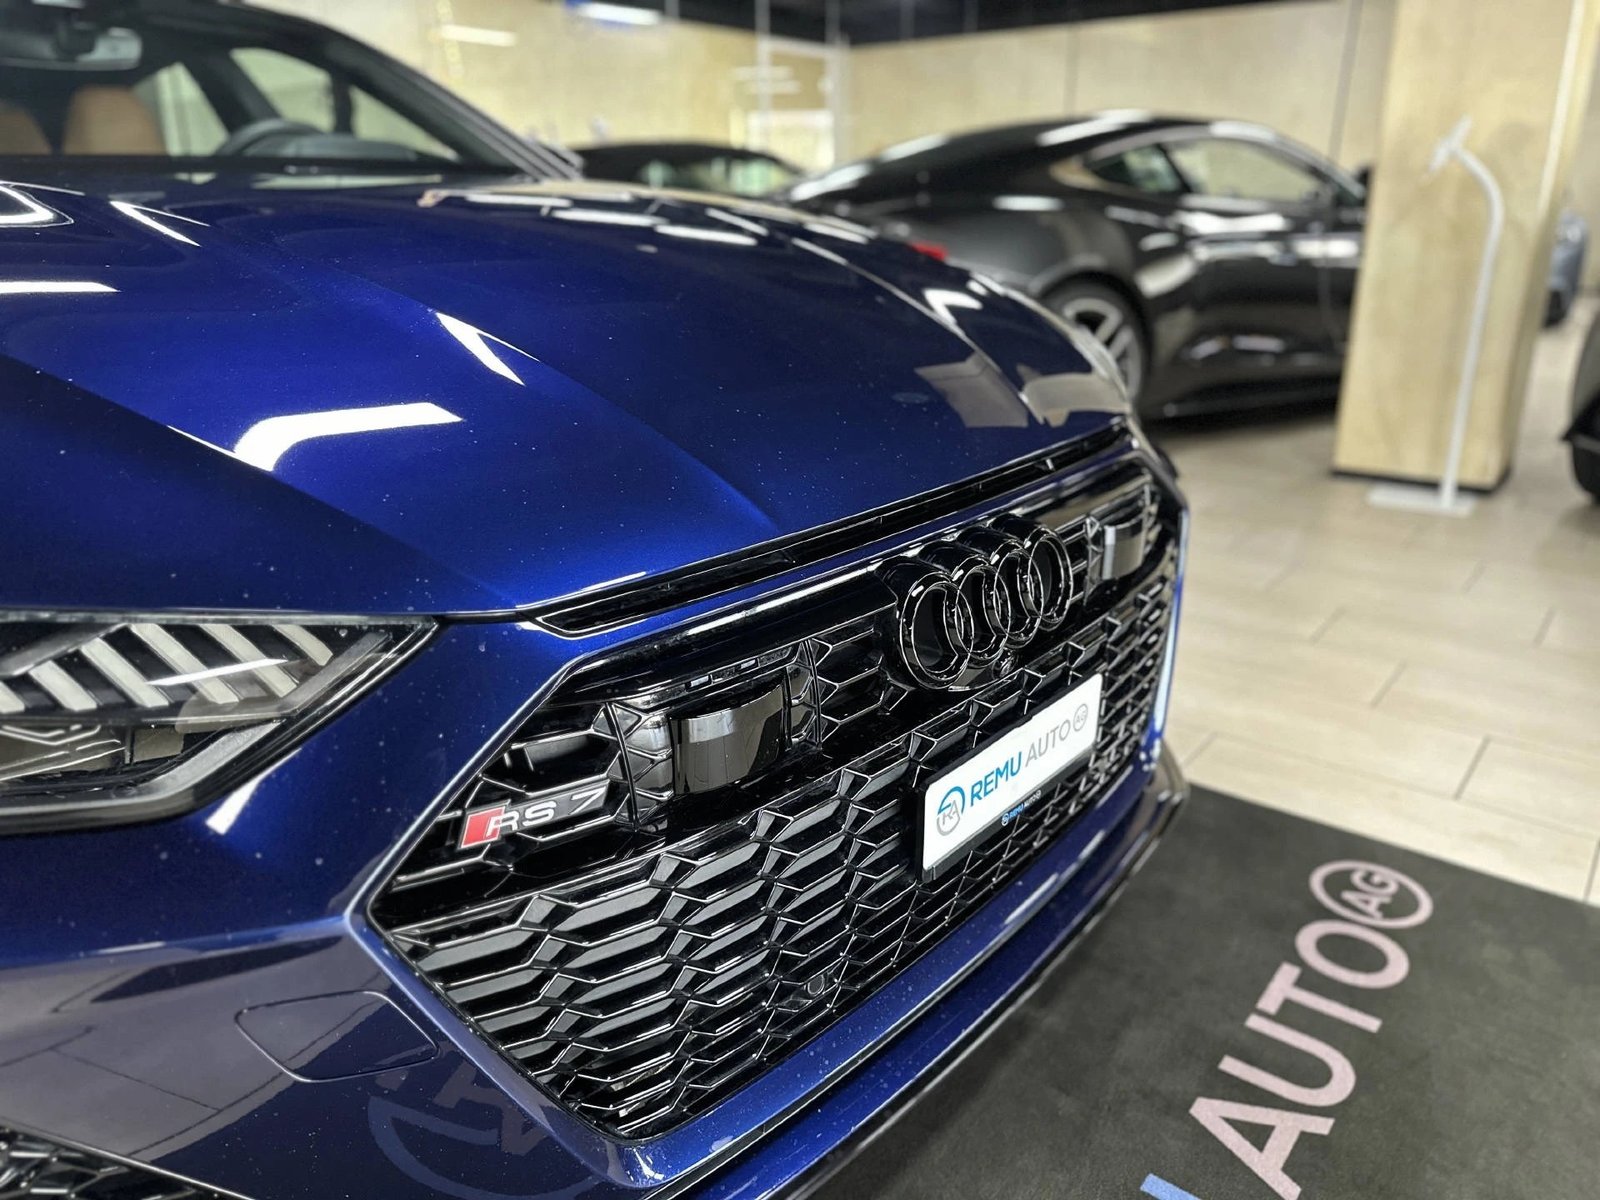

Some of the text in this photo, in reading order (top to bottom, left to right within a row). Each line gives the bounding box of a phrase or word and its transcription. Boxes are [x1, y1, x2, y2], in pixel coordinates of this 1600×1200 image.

[969, 751, 1022, 807] REMU
[1025, 719, 1071, 767] AUTO
[485, 786, 607, 838] RS 7
[1188, 868, 1410, 1200] AUTO AG
